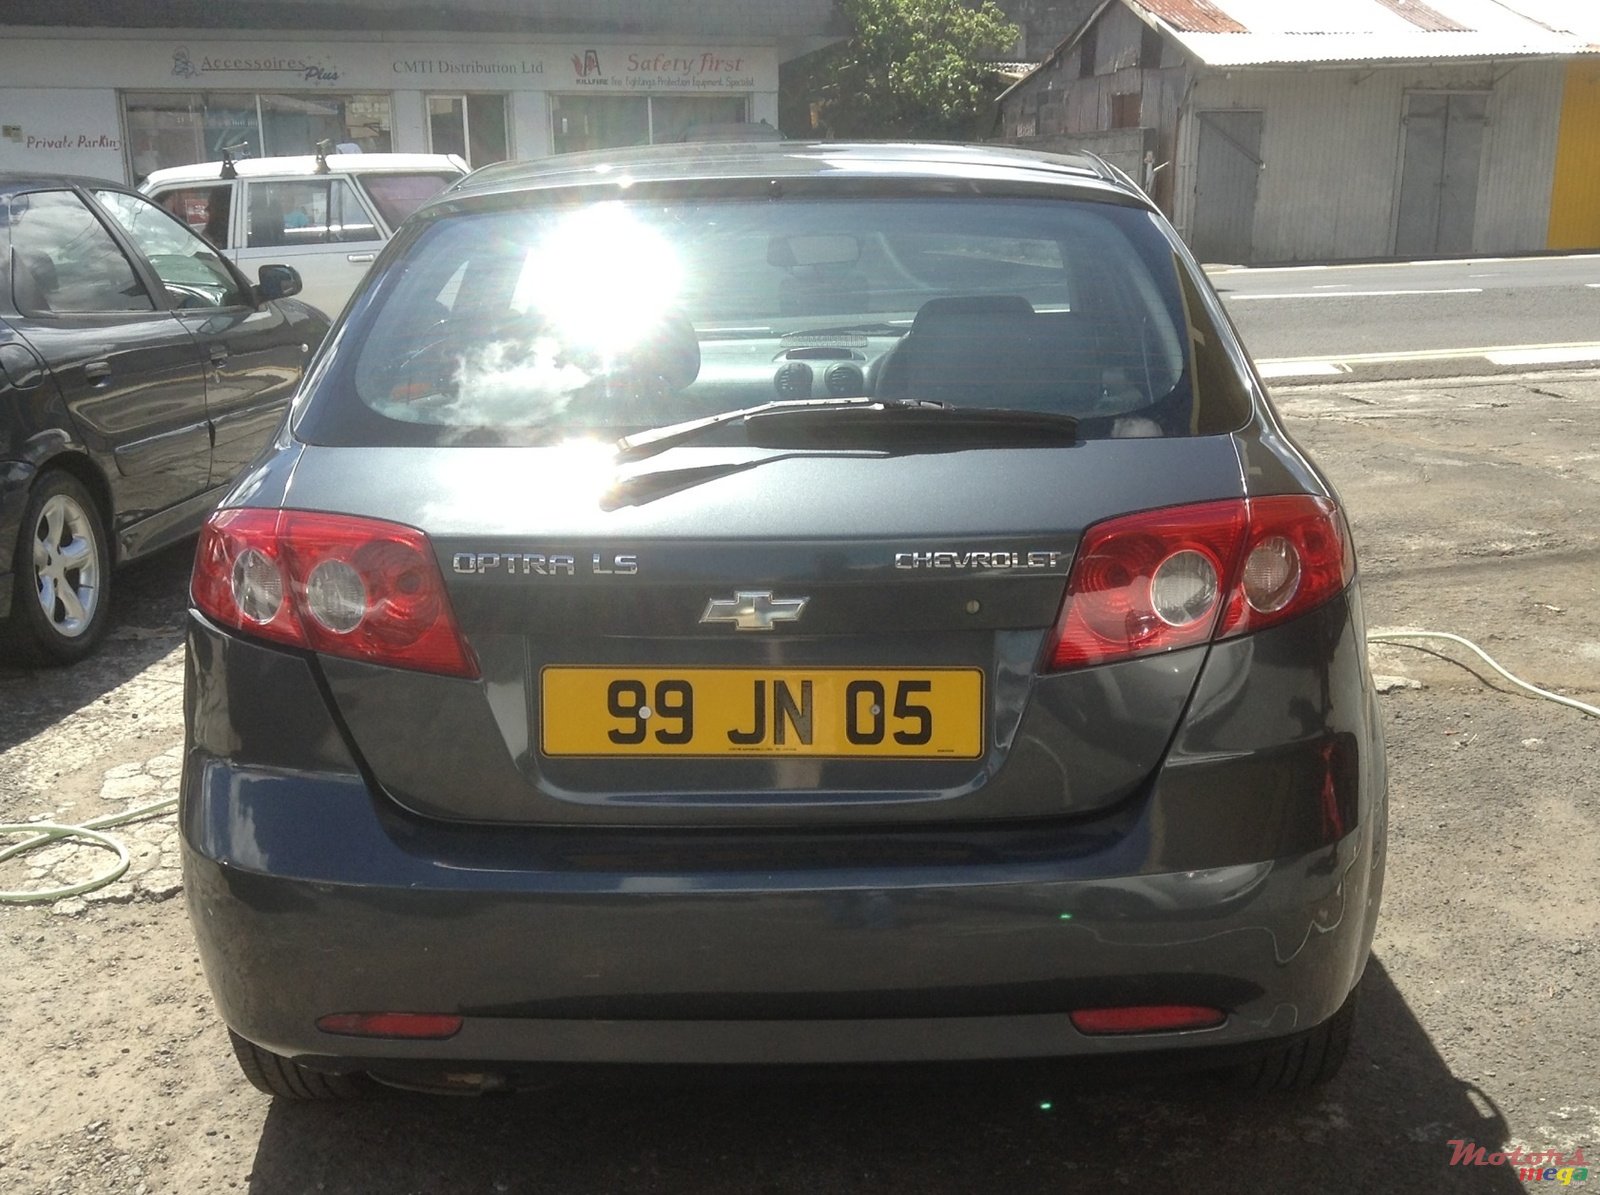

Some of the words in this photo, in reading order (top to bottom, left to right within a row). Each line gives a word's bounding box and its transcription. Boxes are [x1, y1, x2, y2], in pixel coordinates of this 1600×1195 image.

[201, 56, 306, 69] Accessoires
[438, 60, 517, 73] Distribution
[521, 61, 544, 73] Ltd
[626, 53, 695, 76] Safety
[304, 66, 339, 81] Plus
[692, 76, 724, 88] Equipment
[26, 135, 74, 149] Private
[452, 552, 575, 577] OPTRA
[593, 554, 639, 577] LS
[894, 550, 1063, 571] CHEVROLET
[607, 680, 693, 745] 99
[727, 680, 812, 745] JN
[846, 680, 932, 745] 05
